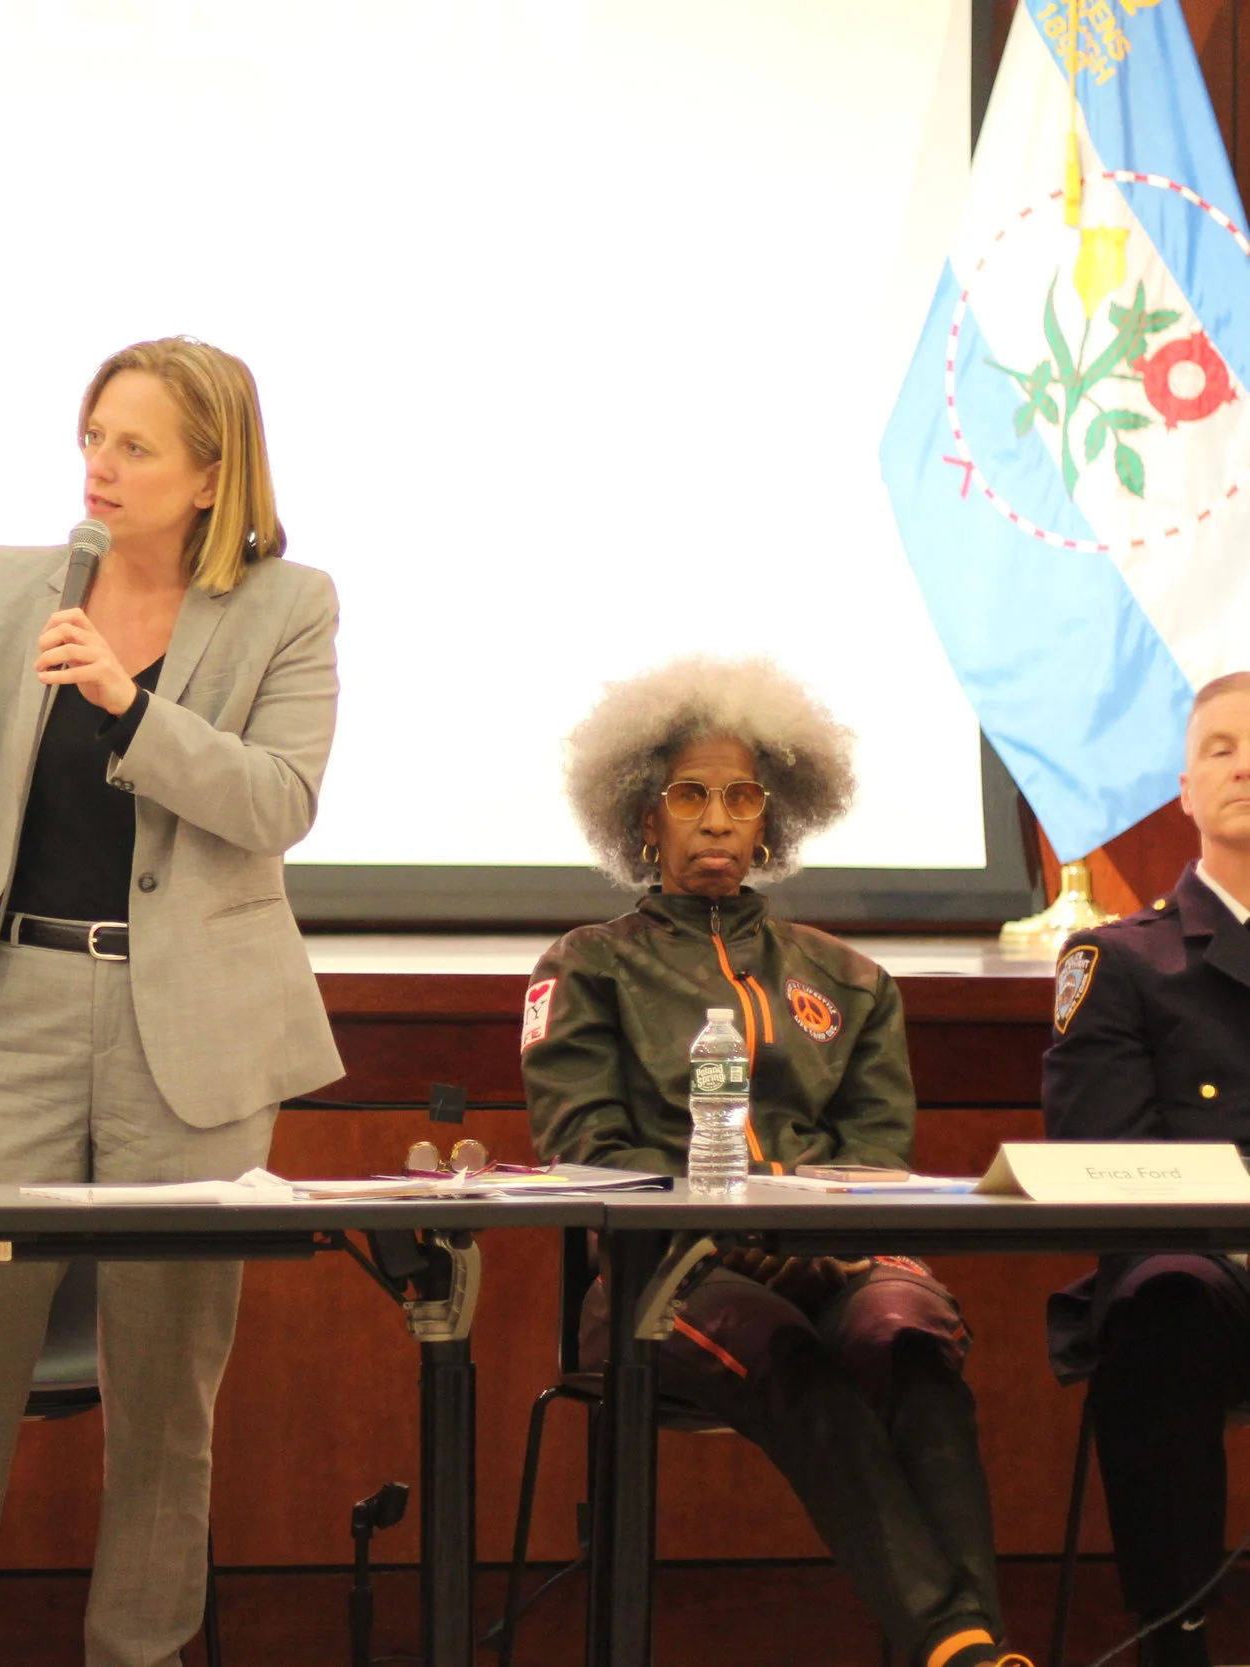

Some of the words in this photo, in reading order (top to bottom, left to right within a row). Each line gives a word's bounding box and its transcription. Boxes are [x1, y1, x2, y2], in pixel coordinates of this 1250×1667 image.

[696, 1064, 724, 1078] Poland
[697, 1073, 727, 1089] Spring
[1085, 1167, 1134, 1179] Erica
[1136, 1167, 1182, 1179] Ford
